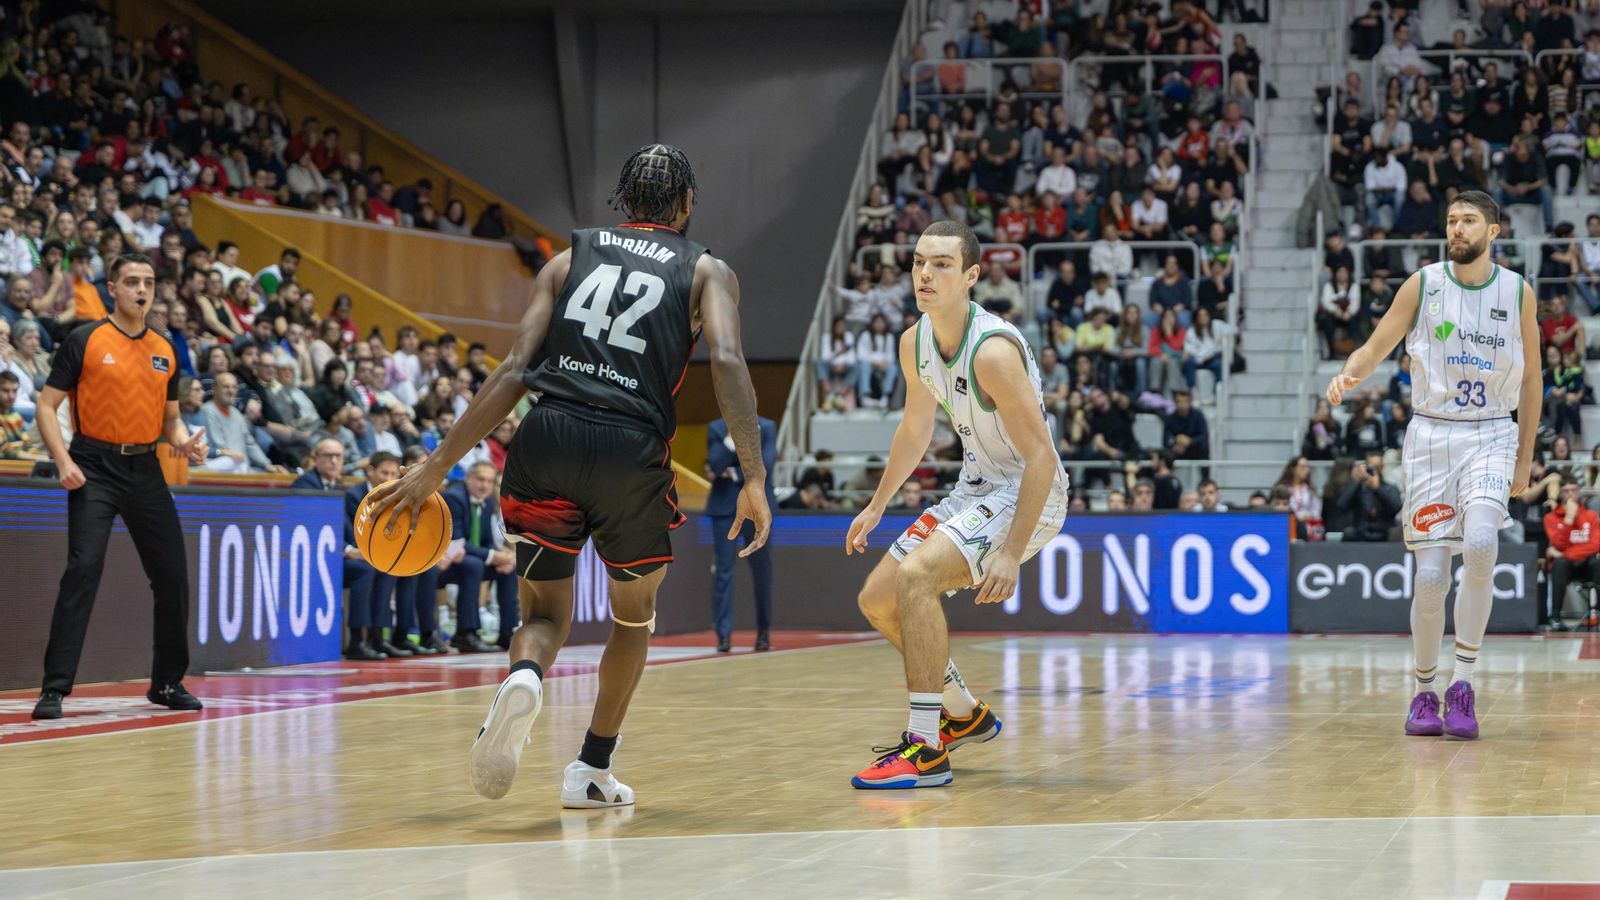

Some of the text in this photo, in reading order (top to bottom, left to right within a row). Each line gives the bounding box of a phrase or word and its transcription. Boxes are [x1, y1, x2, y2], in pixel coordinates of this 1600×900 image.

[599, 231, 676, 264] DURHAM
[563, 263, 666, 355] 42
[1457, 328, 1505, 349] Unicaja
[558, 354, 638, 390] Kave Home
[1446, 351, 1493, 371] málaga
[1454, 379, 1487, 408] 33
[198, 523, 336, 645] IONOS
[1296, 552, 1525, 600] enda
